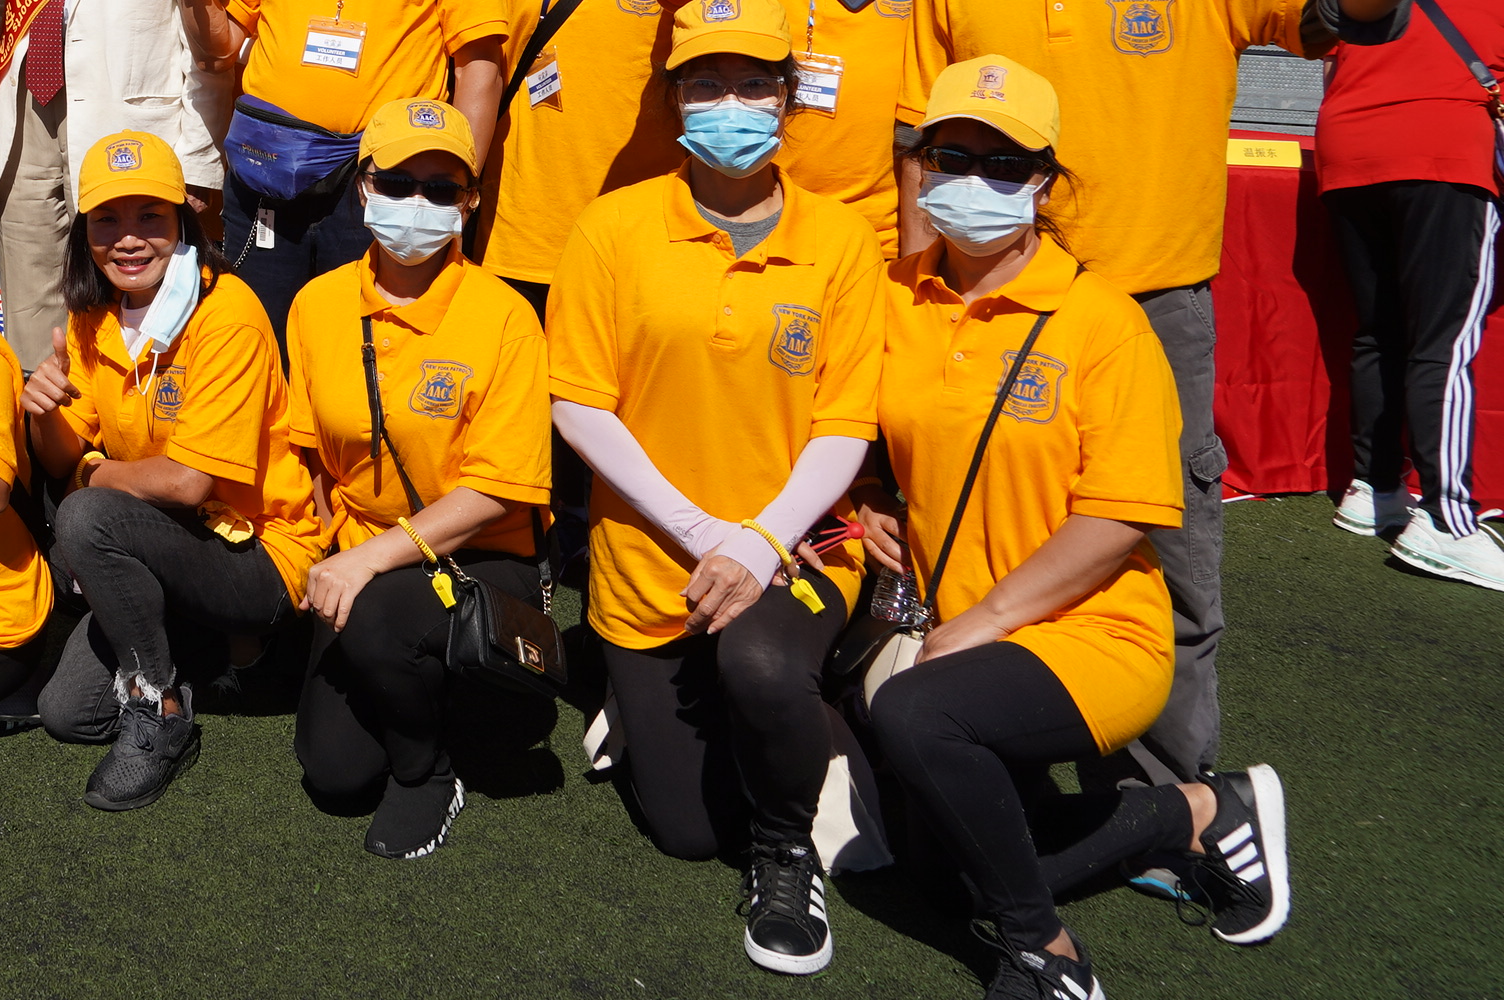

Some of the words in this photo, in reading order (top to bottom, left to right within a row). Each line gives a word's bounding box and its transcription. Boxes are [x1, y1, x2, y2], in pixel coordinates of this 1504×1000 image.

[1131, 21, 1155, 34] AAC
[317, 47, 346, 56] VOLUNTEER
[788, 338, 806, 354] AAC
[160, 391, 178, 404] AAC
[426, 385, 448, 399] AAC
[1011, 382, 1039, 400] AAC
